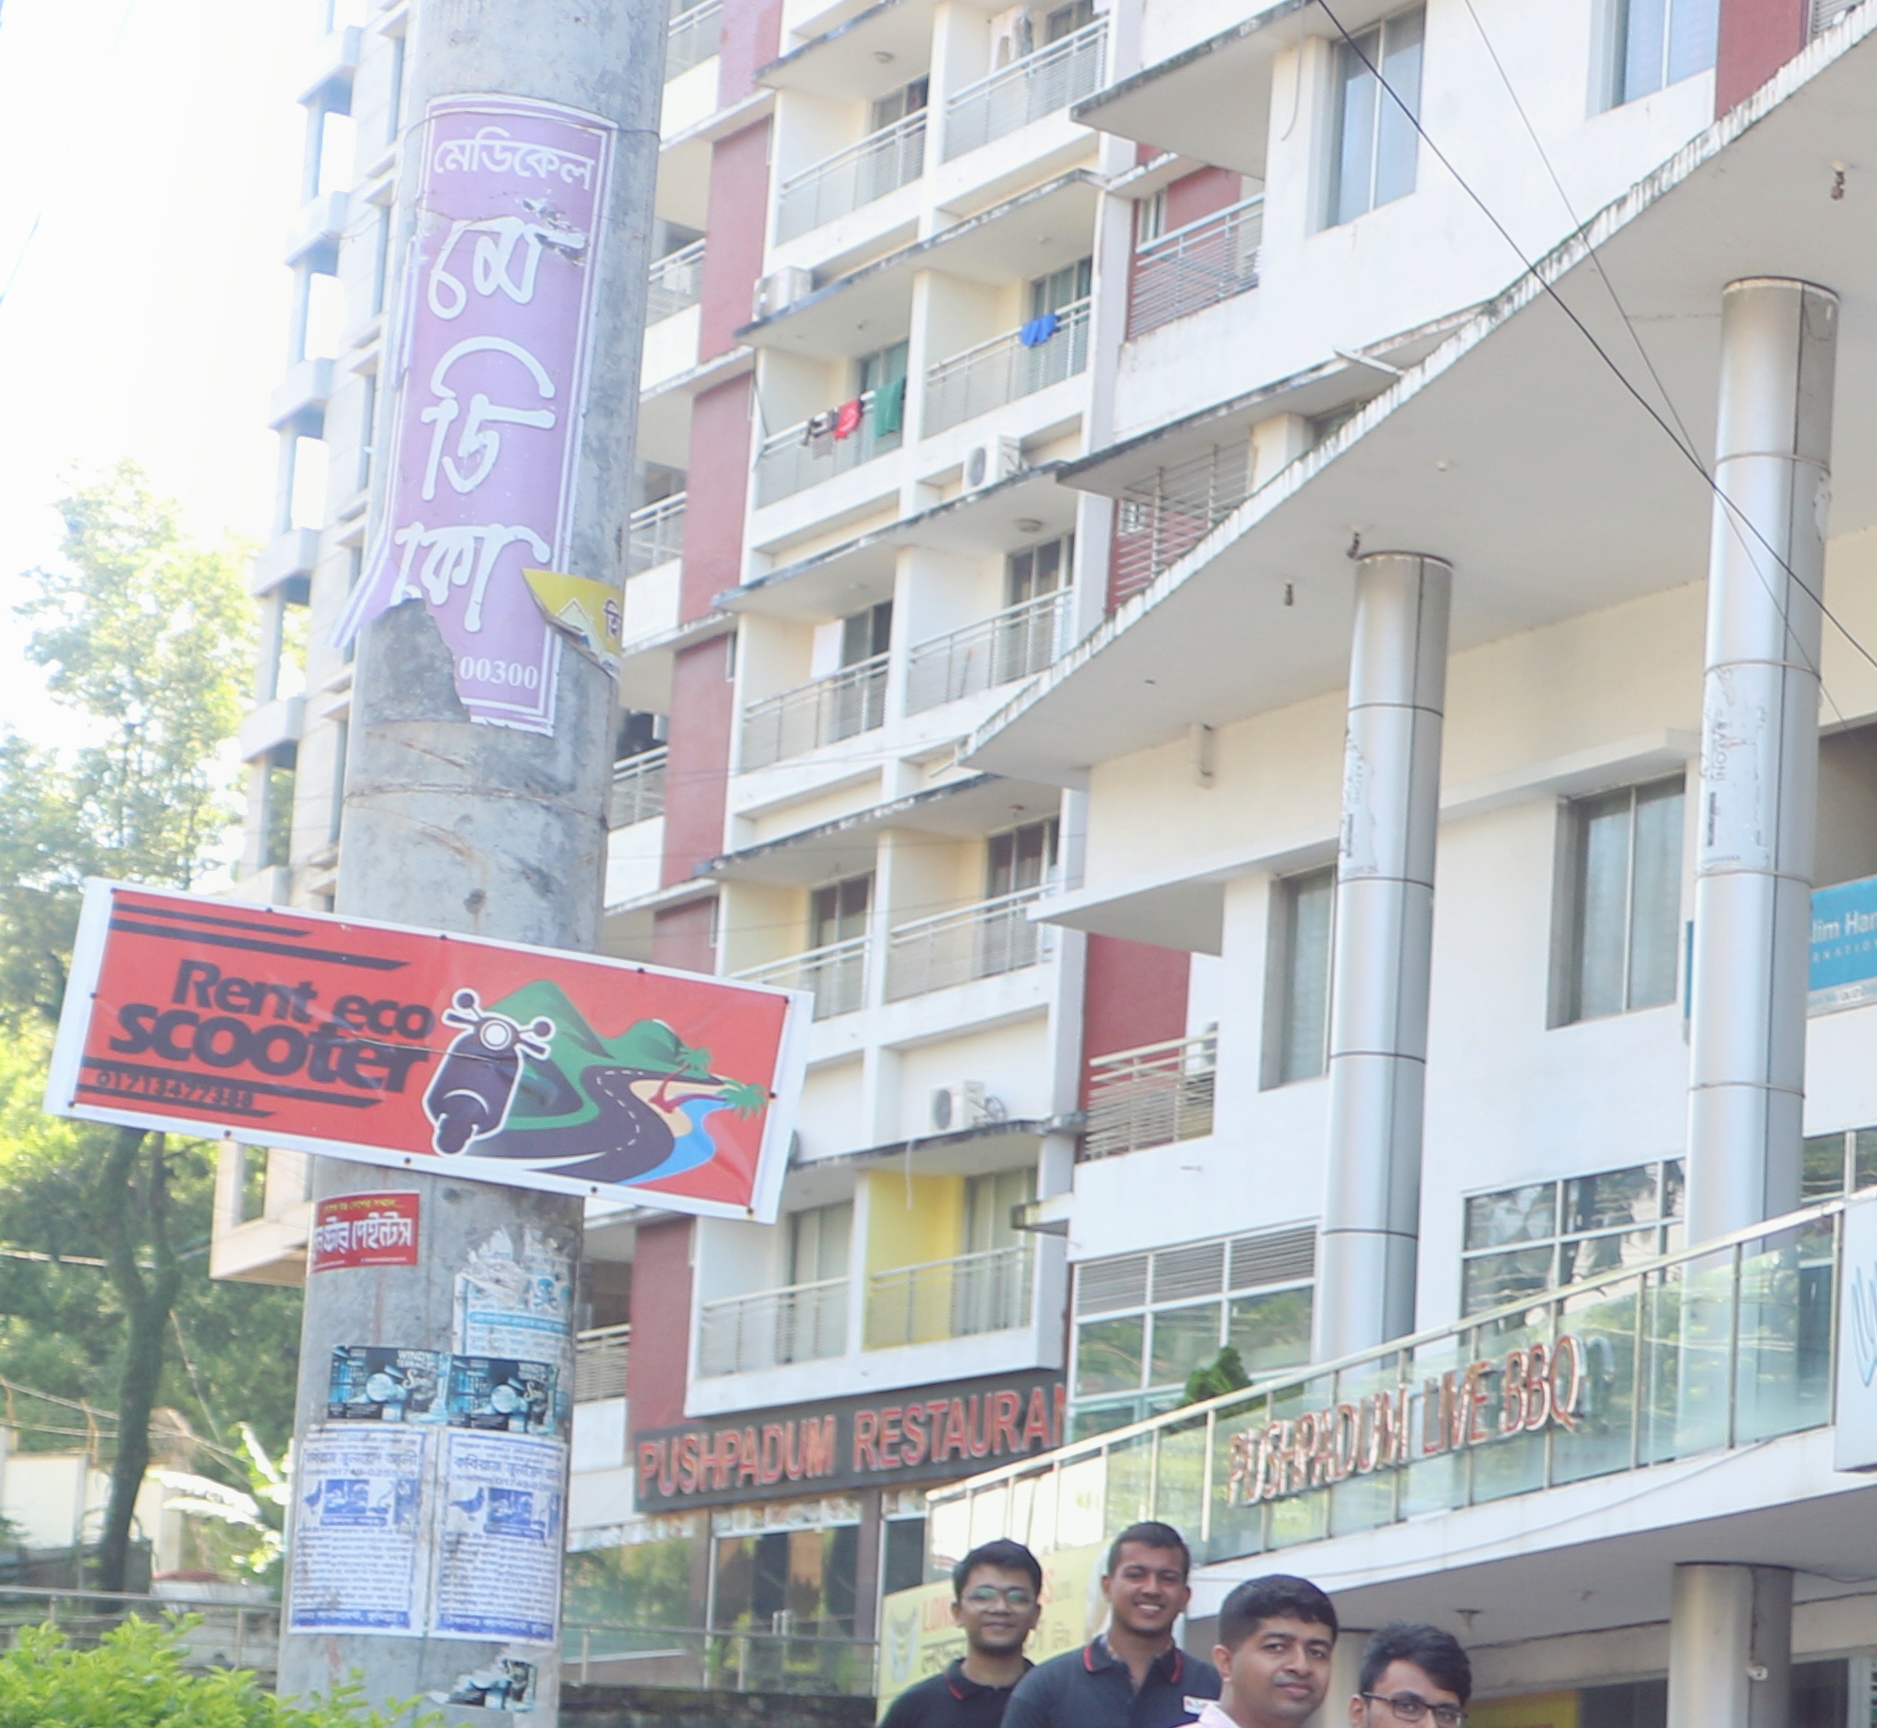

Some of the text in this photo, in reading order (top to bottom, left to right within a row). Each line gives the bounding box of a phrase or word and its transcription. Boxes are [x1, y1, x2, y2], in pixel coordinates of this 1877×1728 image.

[433, 125, 595, 190] মেডিকেল
[171, 959, 436, 1040] Rent eco
[108, 1002, 430, 1094] scooter
[638, 1414, 837, 1499] PUSHPADUM
[853, 1382, 1067, 1473] RESTAURAN
[1227, 1334, 1586, 1508] PUSHPADUM LIVE BBQ
